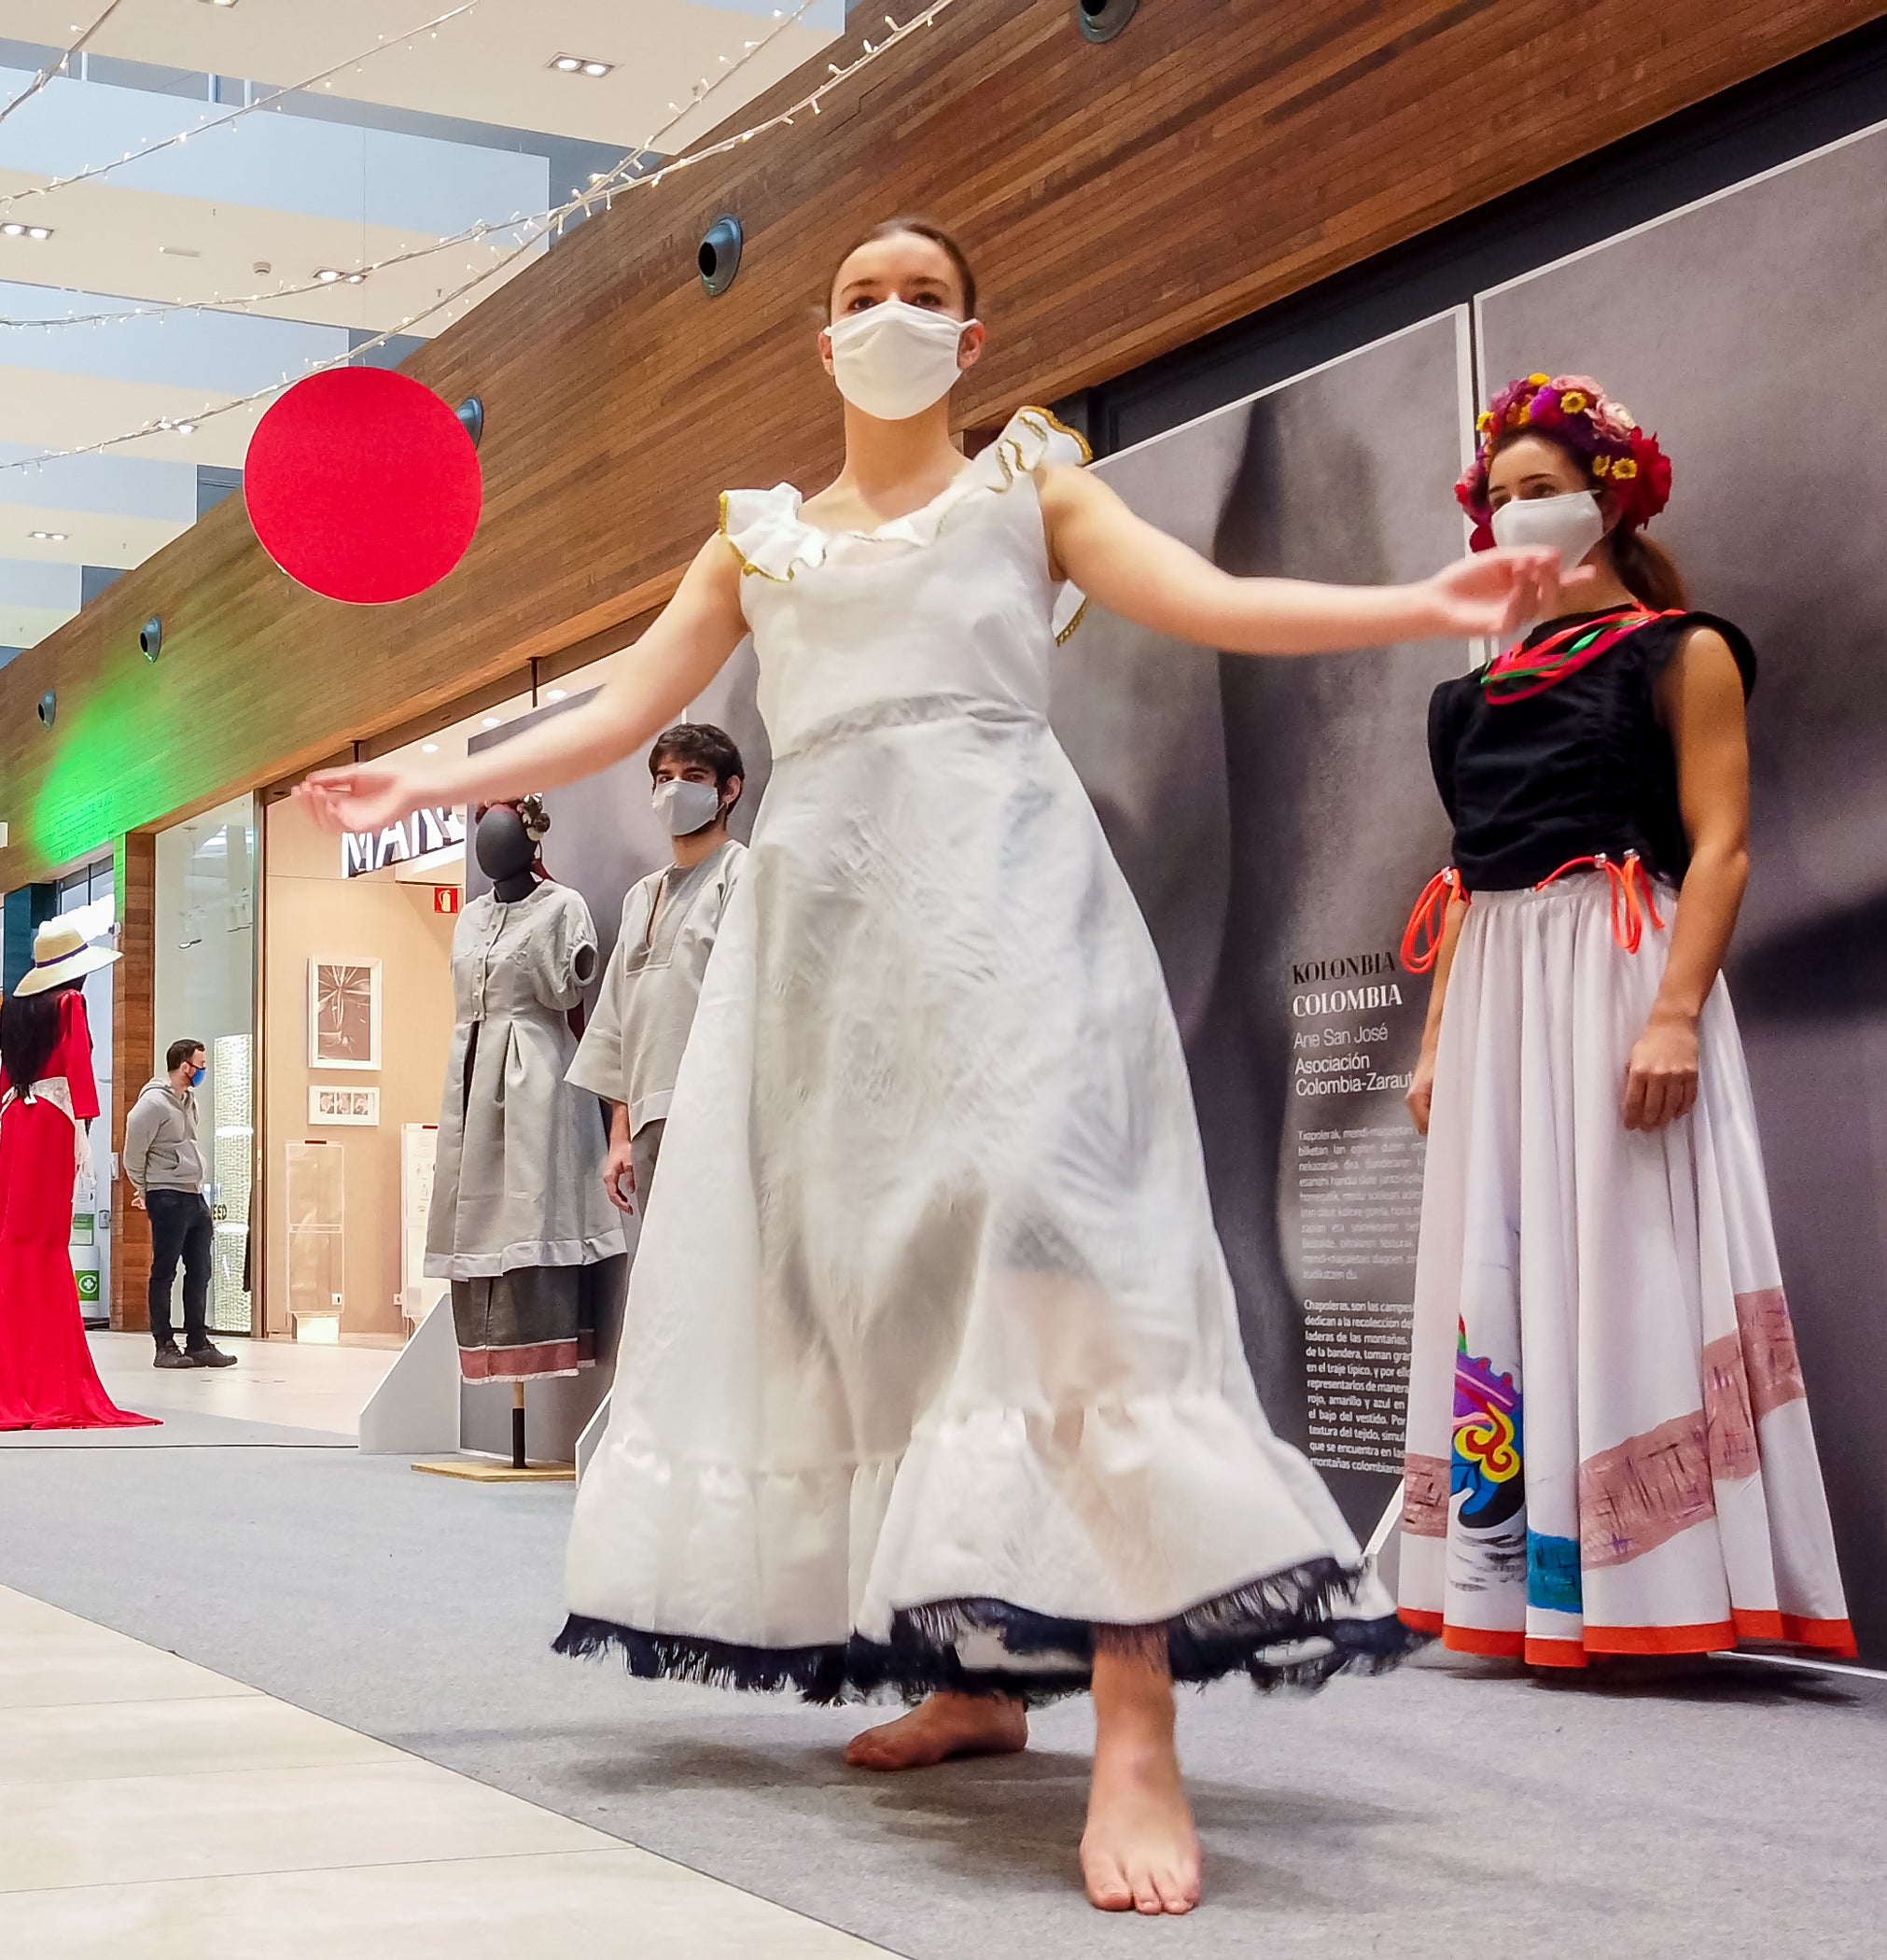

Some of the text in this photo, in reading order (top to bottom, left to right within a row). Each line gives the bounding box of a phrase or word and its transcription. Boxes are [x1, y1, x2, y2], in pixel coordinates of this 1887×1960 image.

[1293, 951, 1396, 985] KOLONBIA
[1293, 984, 1403, 1017] COLOMBIA
[1293, 1022, 1388, 1049] Ane San José
[1295, 1053, 1370, 1075] Asociación
[1350, 1303, 1366, 1311] son
[1367, 1301, 1379, 1312] las
[1305, 1315, 1336, 1327] dedican
[1337, 1318, 1343, 1327] a
[1343, 1317, 1351, 1327] la
[1351, 1317, 1400, 1328] recolección
[1305, 1330, 1335, 1342] laderas
[1336, 1332, 1347, 1343] de
[1349, 1331, 1362, 1343] las
[1306, 1346, 1317, 1357] de
[1317, 1346, 1325, 1357] la
[1326, 1347, 1363, 1360] bandera,
[1363, 1350, 1392, 1361] toman
[1307, 1364, 1317, 1373] en
[1318, 1363, 1326, 1373] el
[1327, 1364, 1346, 1376] traje
[1374, 1367, 1379, 1379] y
[1379, 1367, 1395, 1379] por
[1307, 1379, 1365, 1392] representarlos
[1365, 1380, 1377, 1392] de
[1307, 1393, 1405, 1410] rojo, amarillo y azul en
[1308, 1408, 1316, 1420] el
[1319, 1409, 1336, 1423] bajo
[1339, 1410, 1353, 1421] del
[1355, 1413, 1389, 1425] vestido.
[1308, 1425, 1338, 1436] textura
[1339, 1426, 1353, 1437] del
[1354, 1428, 1380, 1441] tejido,
[1309, 1442, 1325, 1453] que
[1326, 1442, 1336, 1452] se
[1337, 1445, 1379, 1457] encuentra
[1380, 1448, 1391, 1457] en
[1310, 1457, 1350, 1470] montañas
